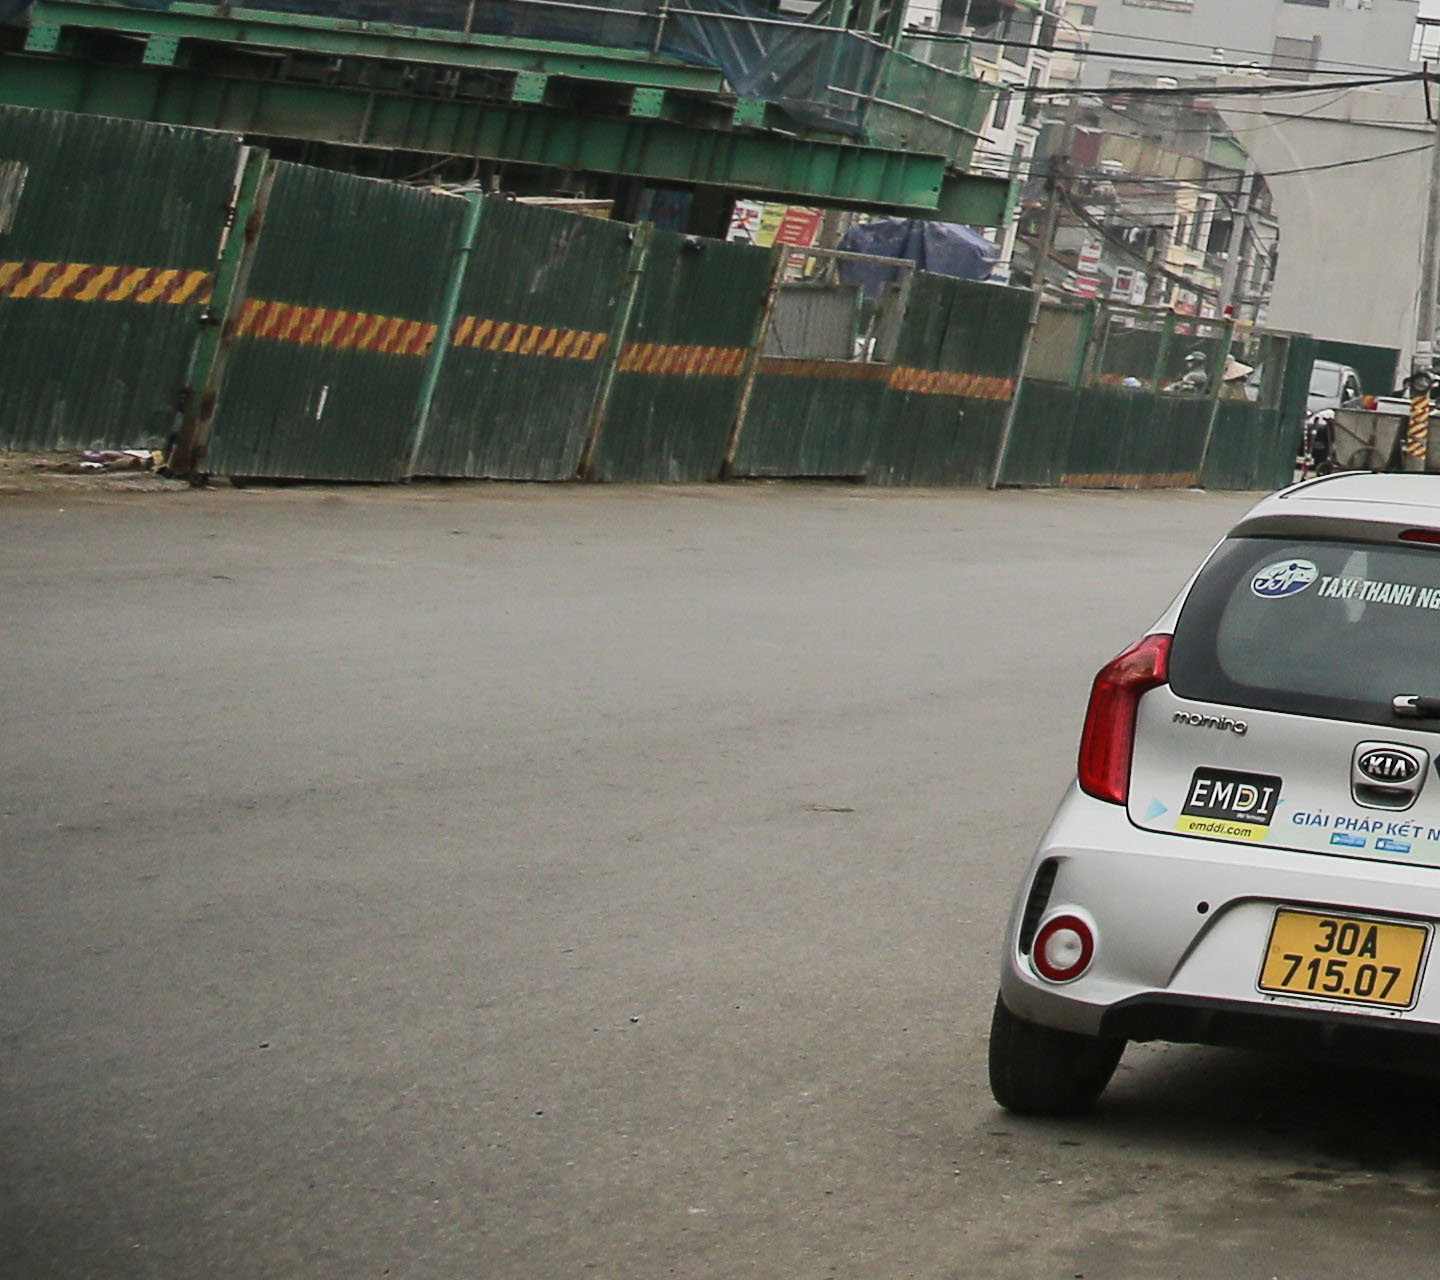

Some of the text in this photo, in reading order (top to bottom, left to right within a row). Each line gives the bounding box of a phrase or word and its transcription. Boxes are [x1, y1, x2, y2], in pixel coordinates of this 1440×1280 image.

[1317, 576, 1358, 599] TAXI
[1359, 581, 1417, 606] THANH
[1172, 710, 1248, 736] morning
[1367, 755, 1407, 777] KIA
[1189, 780, 1274, 815] EMDI
[1189, 821, 1252, 837] emddi.com
[1292, 808, 1330, 828] GIẢI
[1334, 816, 1384, 833] PHÁP
[1386, 819, 1424, 838] KẾT
[1314, 919, 1378, 959] 30A
[1281, 953, 1402, 999] 715.07
